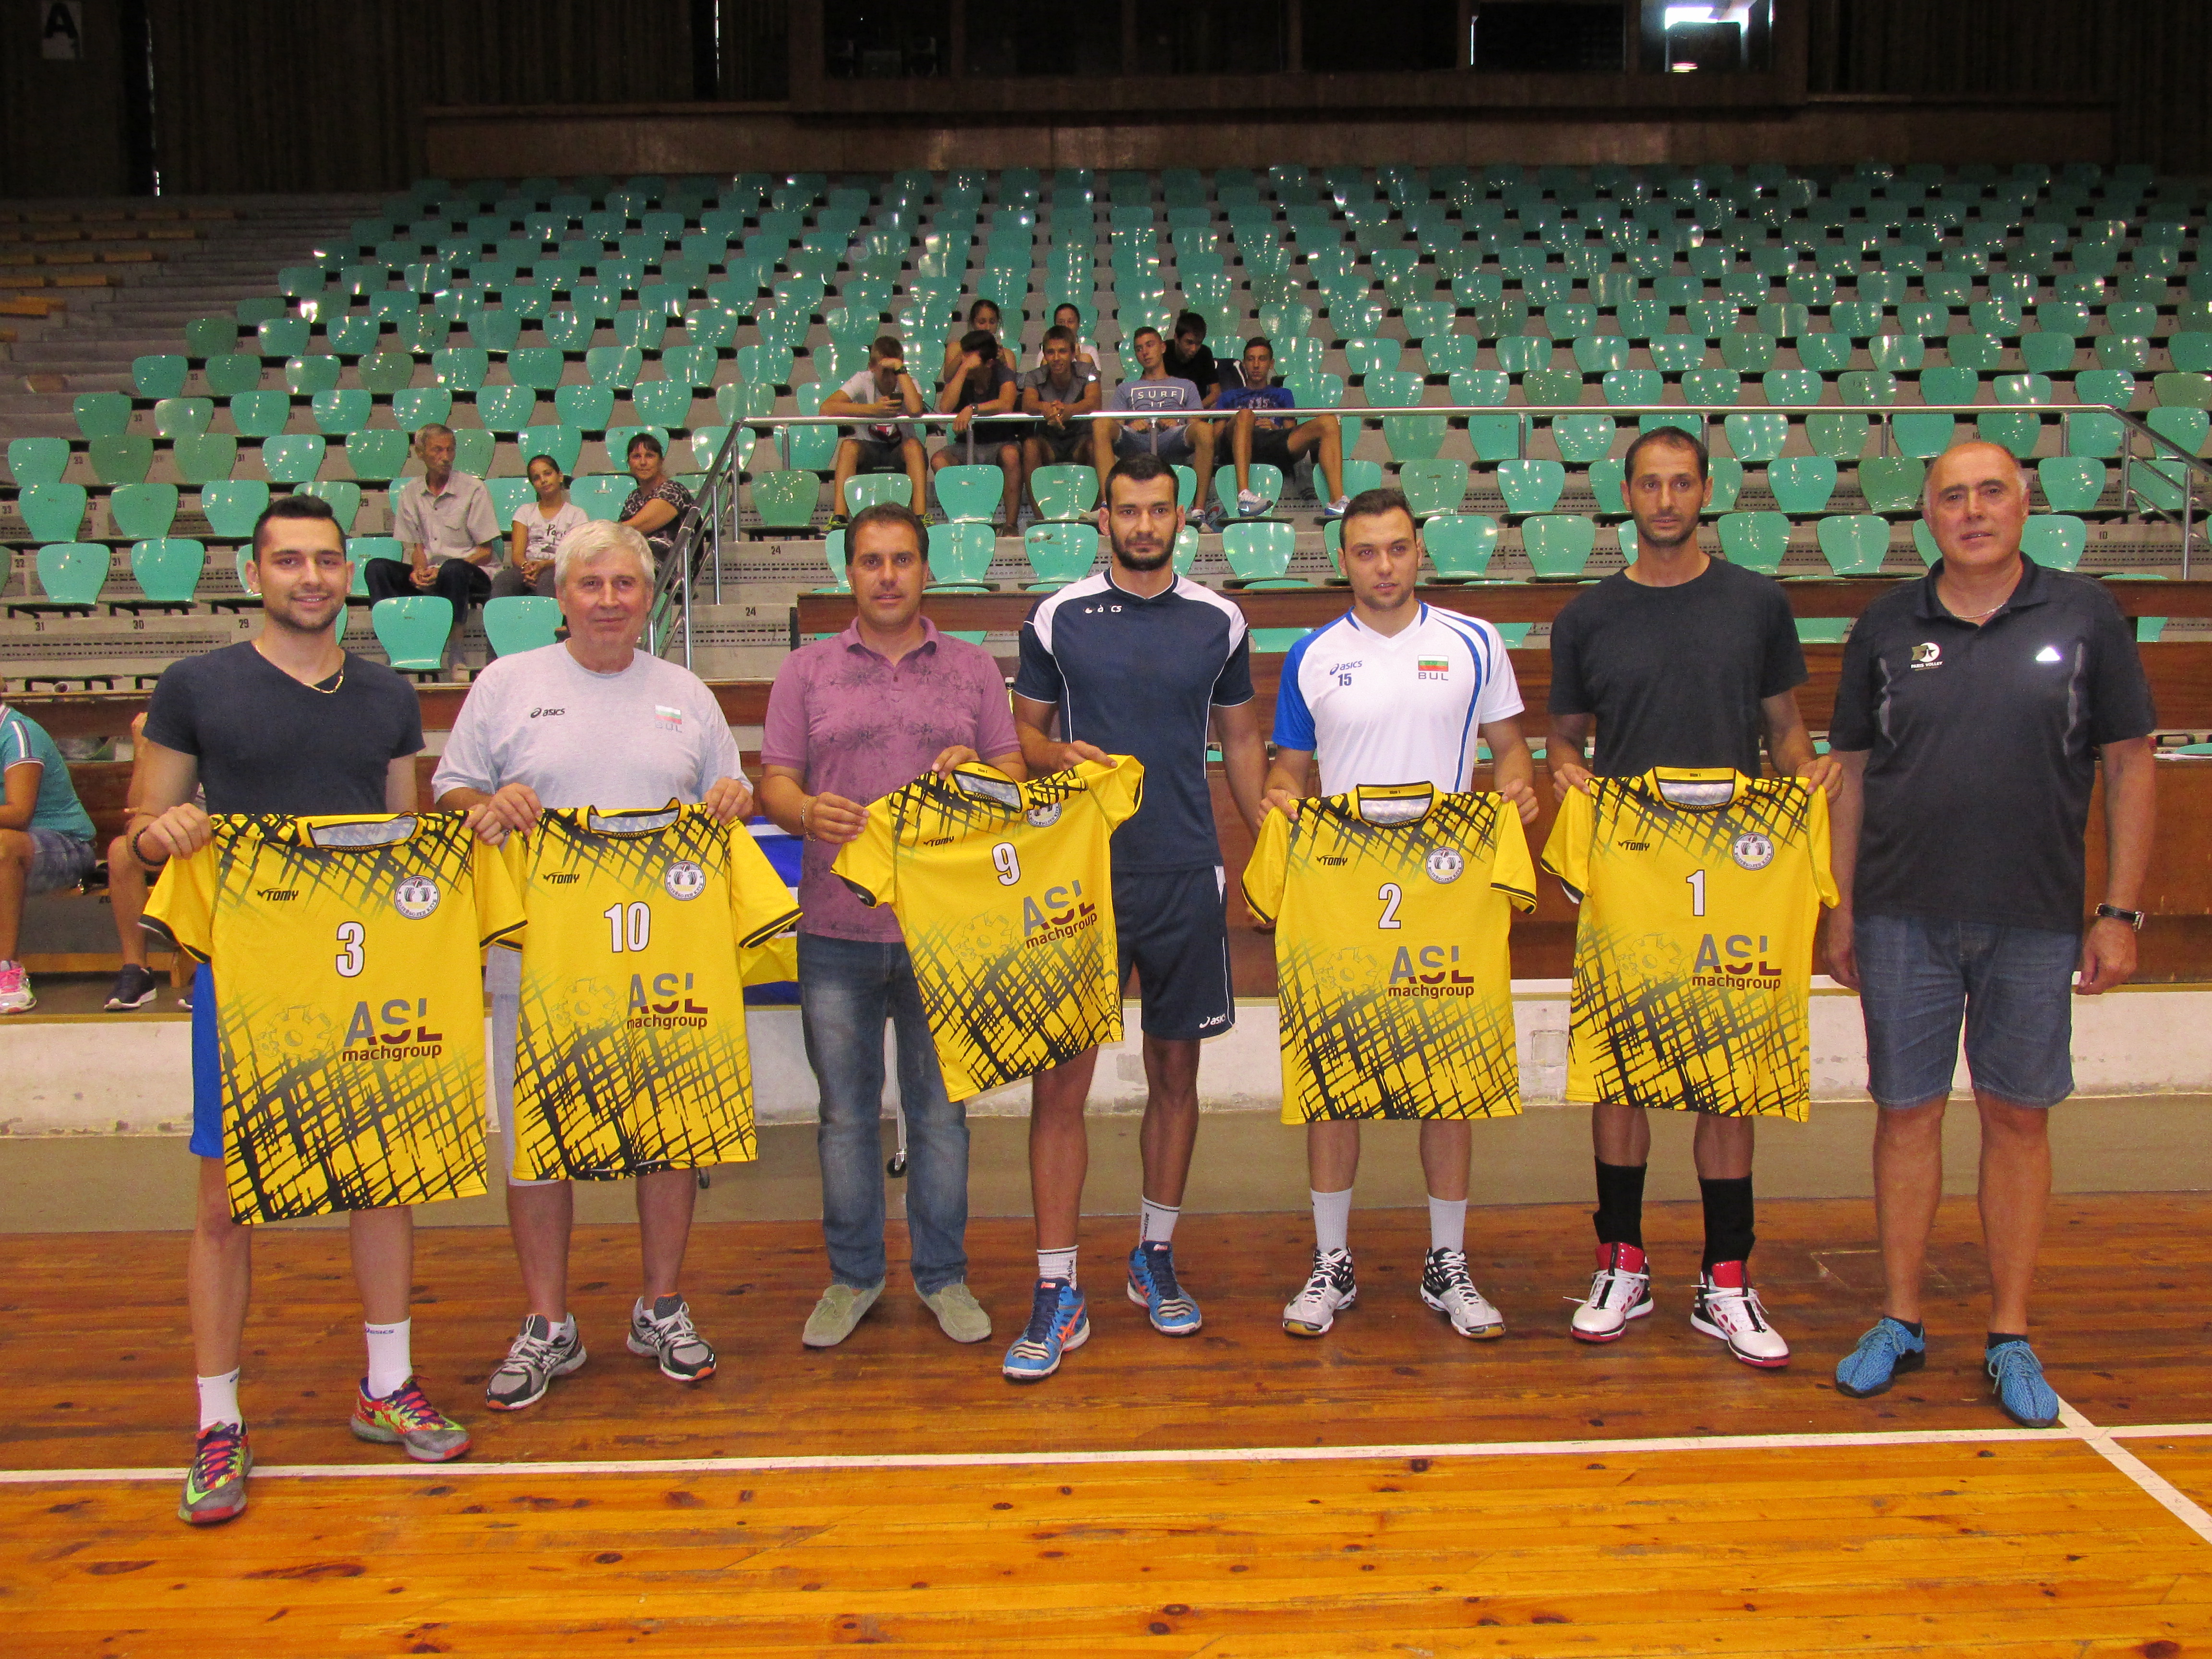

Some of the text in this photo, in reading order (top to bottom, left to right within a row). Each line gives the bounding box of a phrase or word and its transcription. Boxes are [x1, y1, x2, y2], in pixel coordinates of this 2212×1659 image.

[1138, 390, 1177, 399] SURF
[2099, 531, 2108, 540] 10
[771, 545, 781, 555] 24
[746, 607, 756, 616] 24
[36, 622, 45, 631] 31
[133, 620, 144, 629] 30
[239, 619, 249, 628] 29
[1340, 660, 1362, 670] asics
[1338, 673, 1352, 686] 15
[1419, 672, 1448, 680] BUL
[542, 708, 565, 717] asics
[655, 721, 682, 733] BUL
[929, 836, 954, 847] TOMY
[1625, 841, 1650, 851] TOMY
[992, 842, 1021, 886] 9
[1323, 856, 1348, 866] TOMY
[552, 874, 580, 884] TOMY
[266, 889, 299, 901] TOMY
[1685, 869, 1705, 917] 1
[1023, 880, 1095, 937] ASL
[1378, 882, 1402, 929] 2
[604, 902, 651, 952] 10
[1026, 913, 1098, 949] machgroup
[336, 922, 365, 977] 3
[1694, 934, 1781, 976] ASL
[1389, 946, 1474, 985] ASL
[1692, 974, 1781, 992] machgroup
[628, 973, 708, 1016] ASL
[1388, 984, 1474, 999] machgroup
[344, 998, 443, 1047] ASL
[627, 1014, 707, 1030] machgroup
[342, 1045, 442, 1061] machgroup
